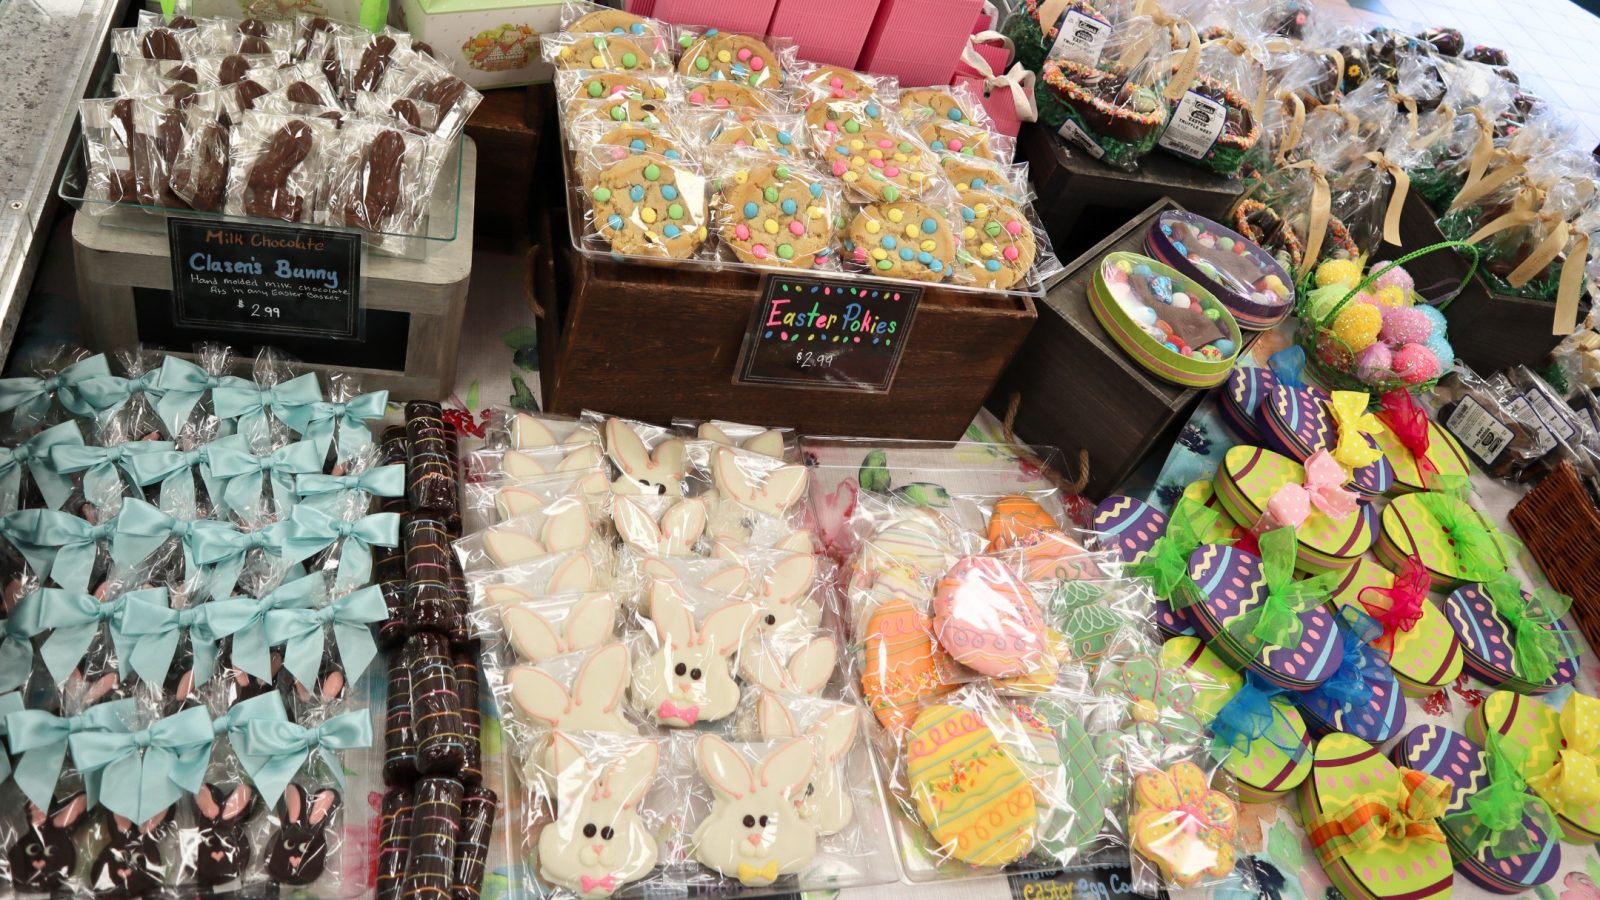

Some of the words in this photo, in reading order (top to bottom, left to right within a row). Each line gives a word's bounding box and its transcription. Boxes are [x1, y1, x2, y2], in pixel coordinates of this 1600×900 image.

[205, 229, 243, 244] Milk
[250, 233, 325, 252] Chocolate
[188, 252, 263, 275] Clasen's
[274, 259, 338, 289] Bunny
[190, 272, 218, 285] Hand
[223, 278, 258, 287] molded
[264, 281, 292, 289] milk
[298, 284, 351, 296] chocolate
[232, 286, 244, 294] in
[247, 288, 269, 297] any
[271, 288, 303, 298] Easter
[766, 298, 838, 330] Easter
[842, 302, 897, 334] Pokies
[796, 348, 834, 368] $2.99
